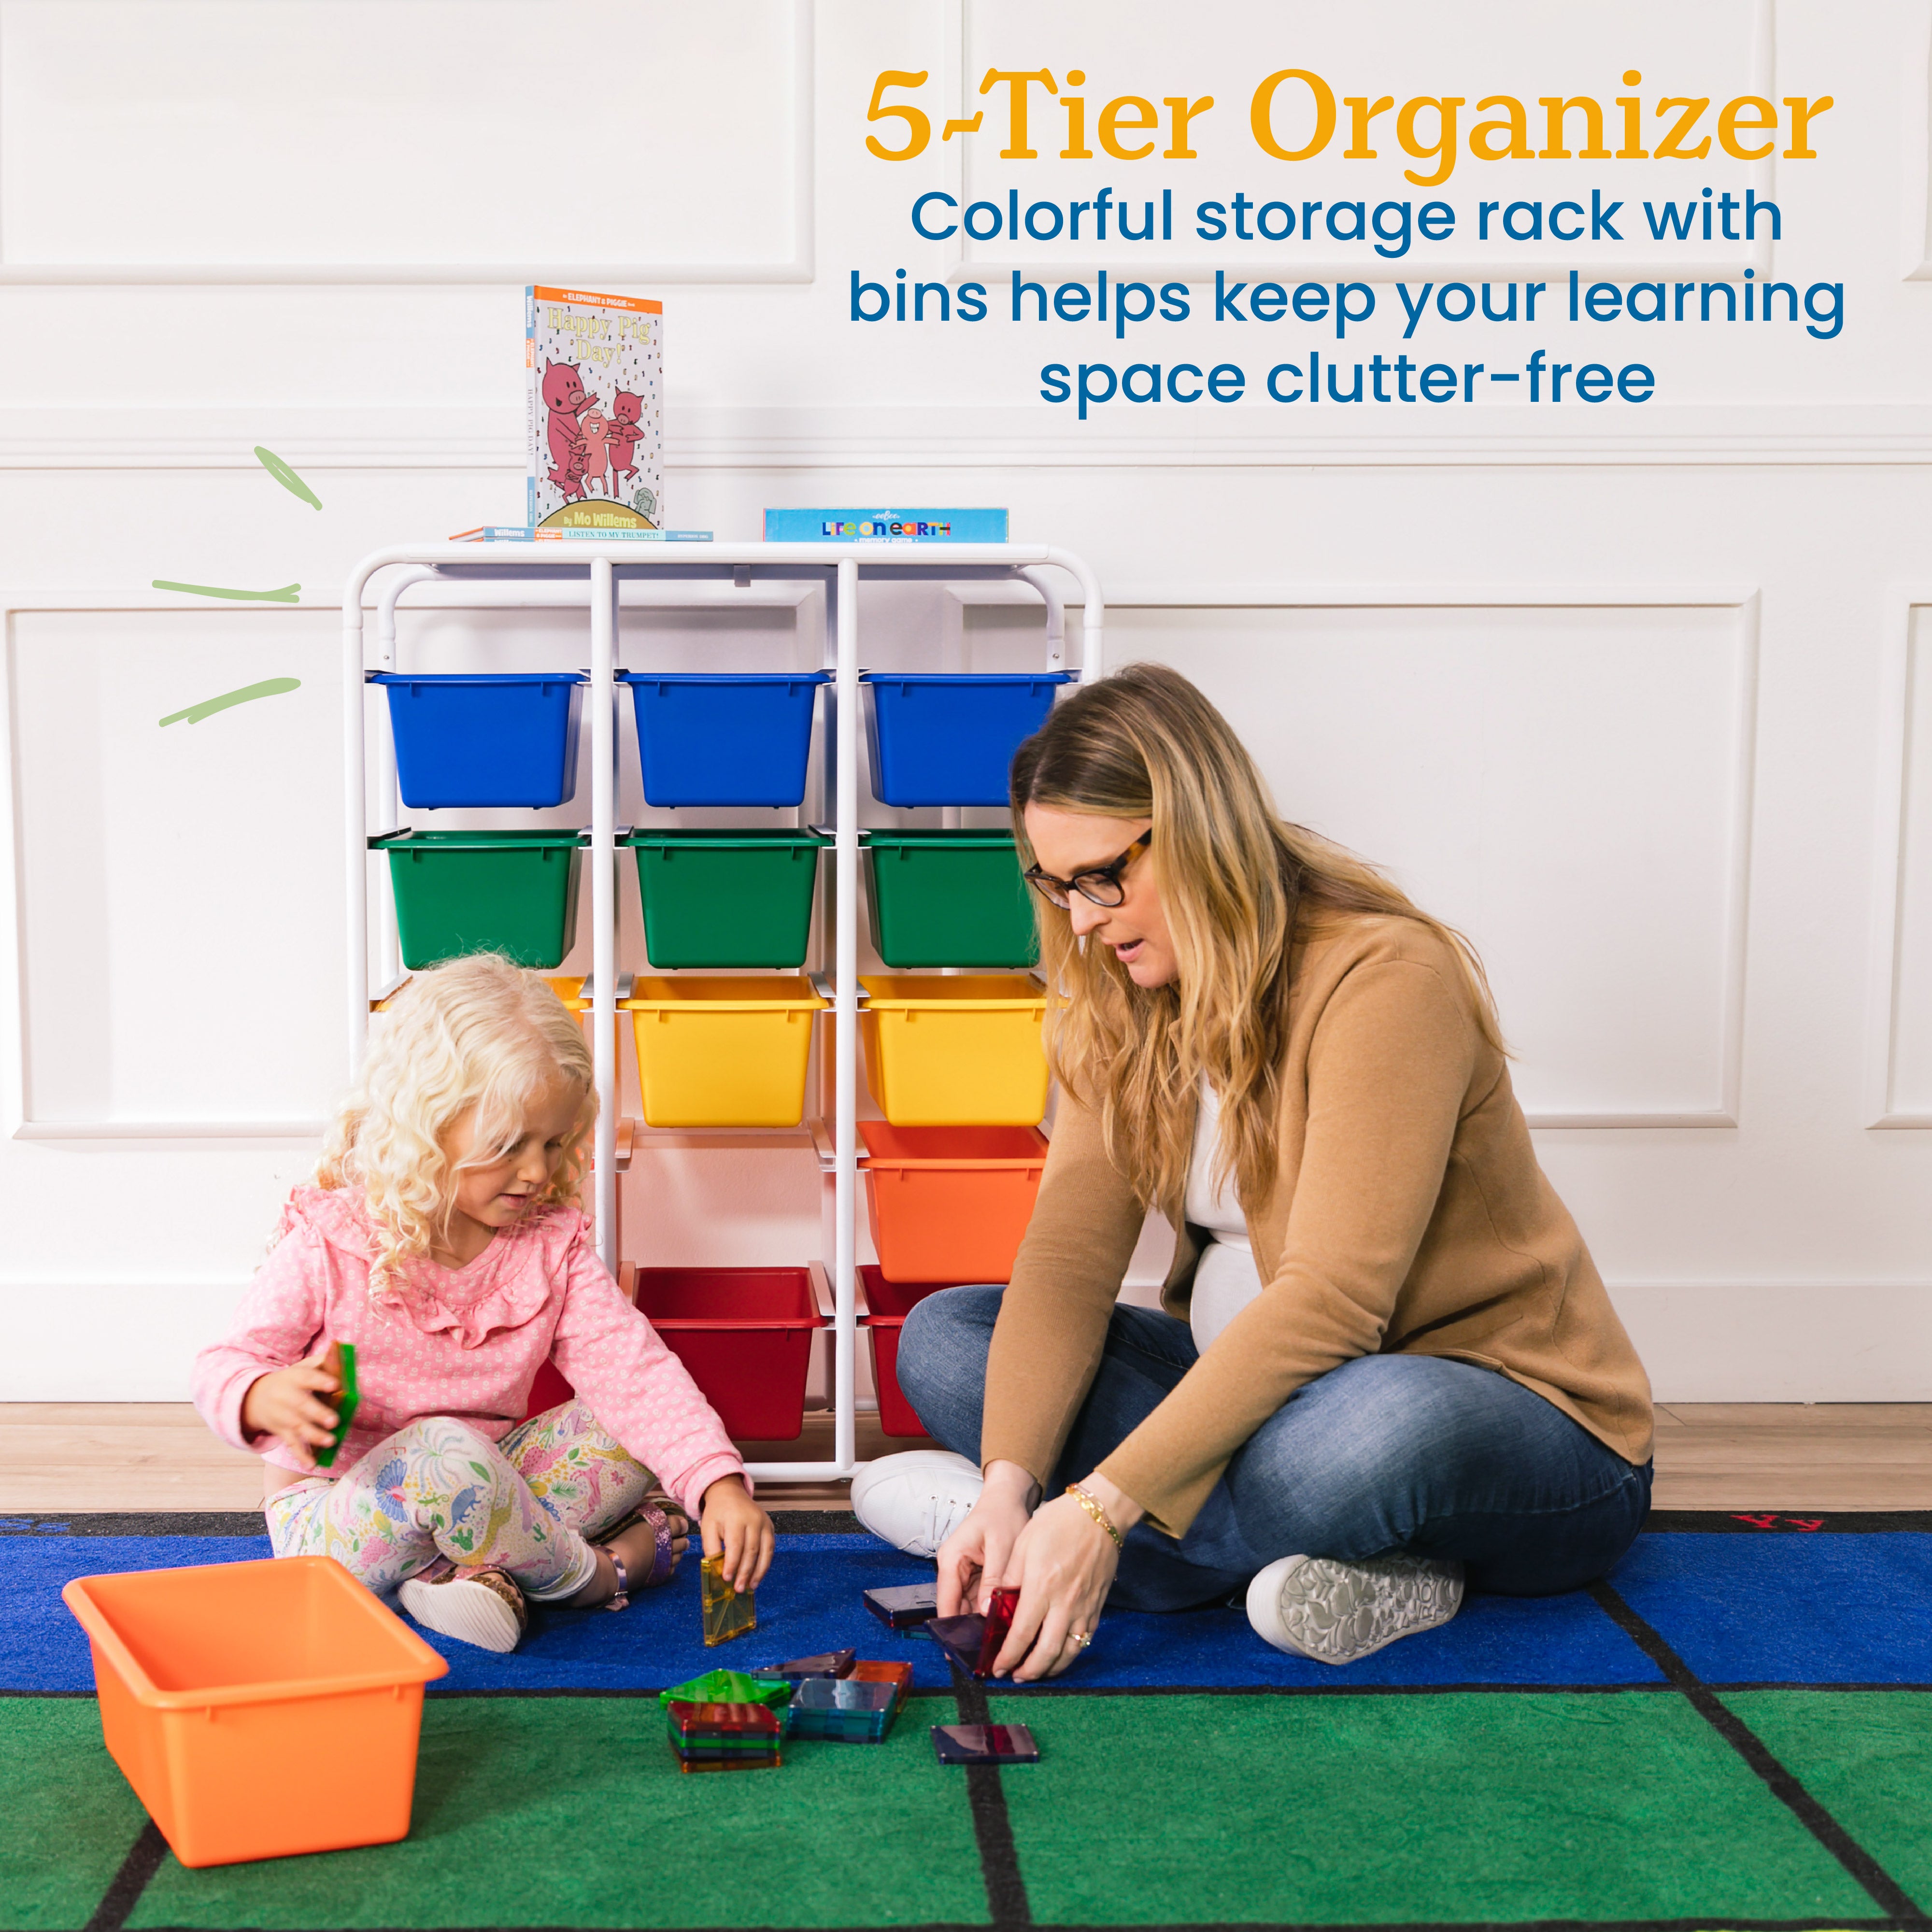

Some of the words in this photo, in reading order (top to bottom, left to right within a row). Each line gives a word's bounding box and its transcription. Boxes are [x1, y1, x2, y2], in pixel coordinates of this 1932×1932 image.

[568, 293, 601, 304] ELEPHANT
[606, 298, 627, 307] PIGGIE
[547, 307, 612, 340] Happy
[618, 316, 652, 344] Pig
[576, 339, 622, 368] Day!
[564, 516, 572, 526] By
[574, 512, 591, 526] Mo
[593, 513, 637, 528] Willems
[494, 529, 525, 537] Willems
